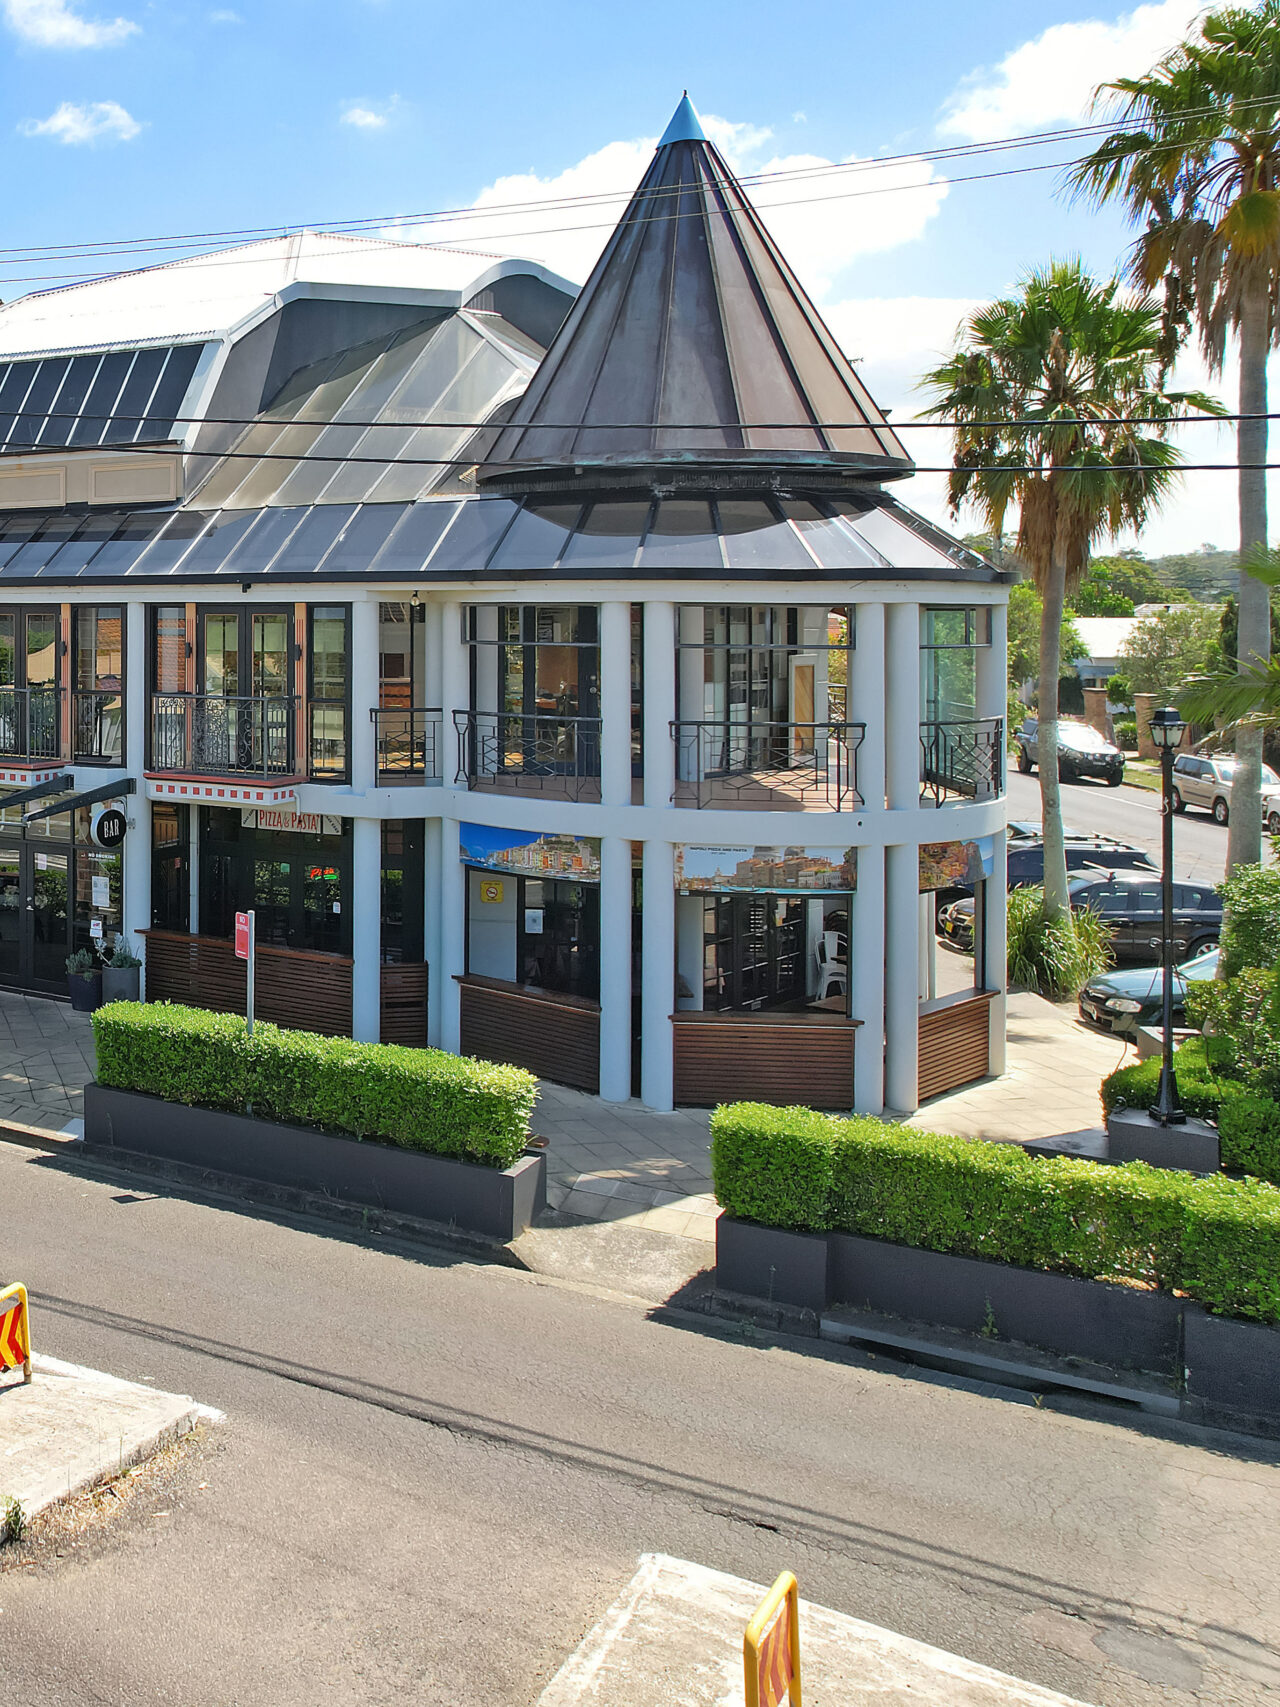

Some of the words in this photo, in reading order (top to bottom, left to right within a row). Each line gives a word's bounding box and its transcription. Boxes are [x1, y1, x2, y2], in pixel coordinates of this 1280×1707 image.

[104, 818, 120, 838] BAR
[260, 809, 281, 828] PIZZA
[292, 811, 317, 830] PASTA
